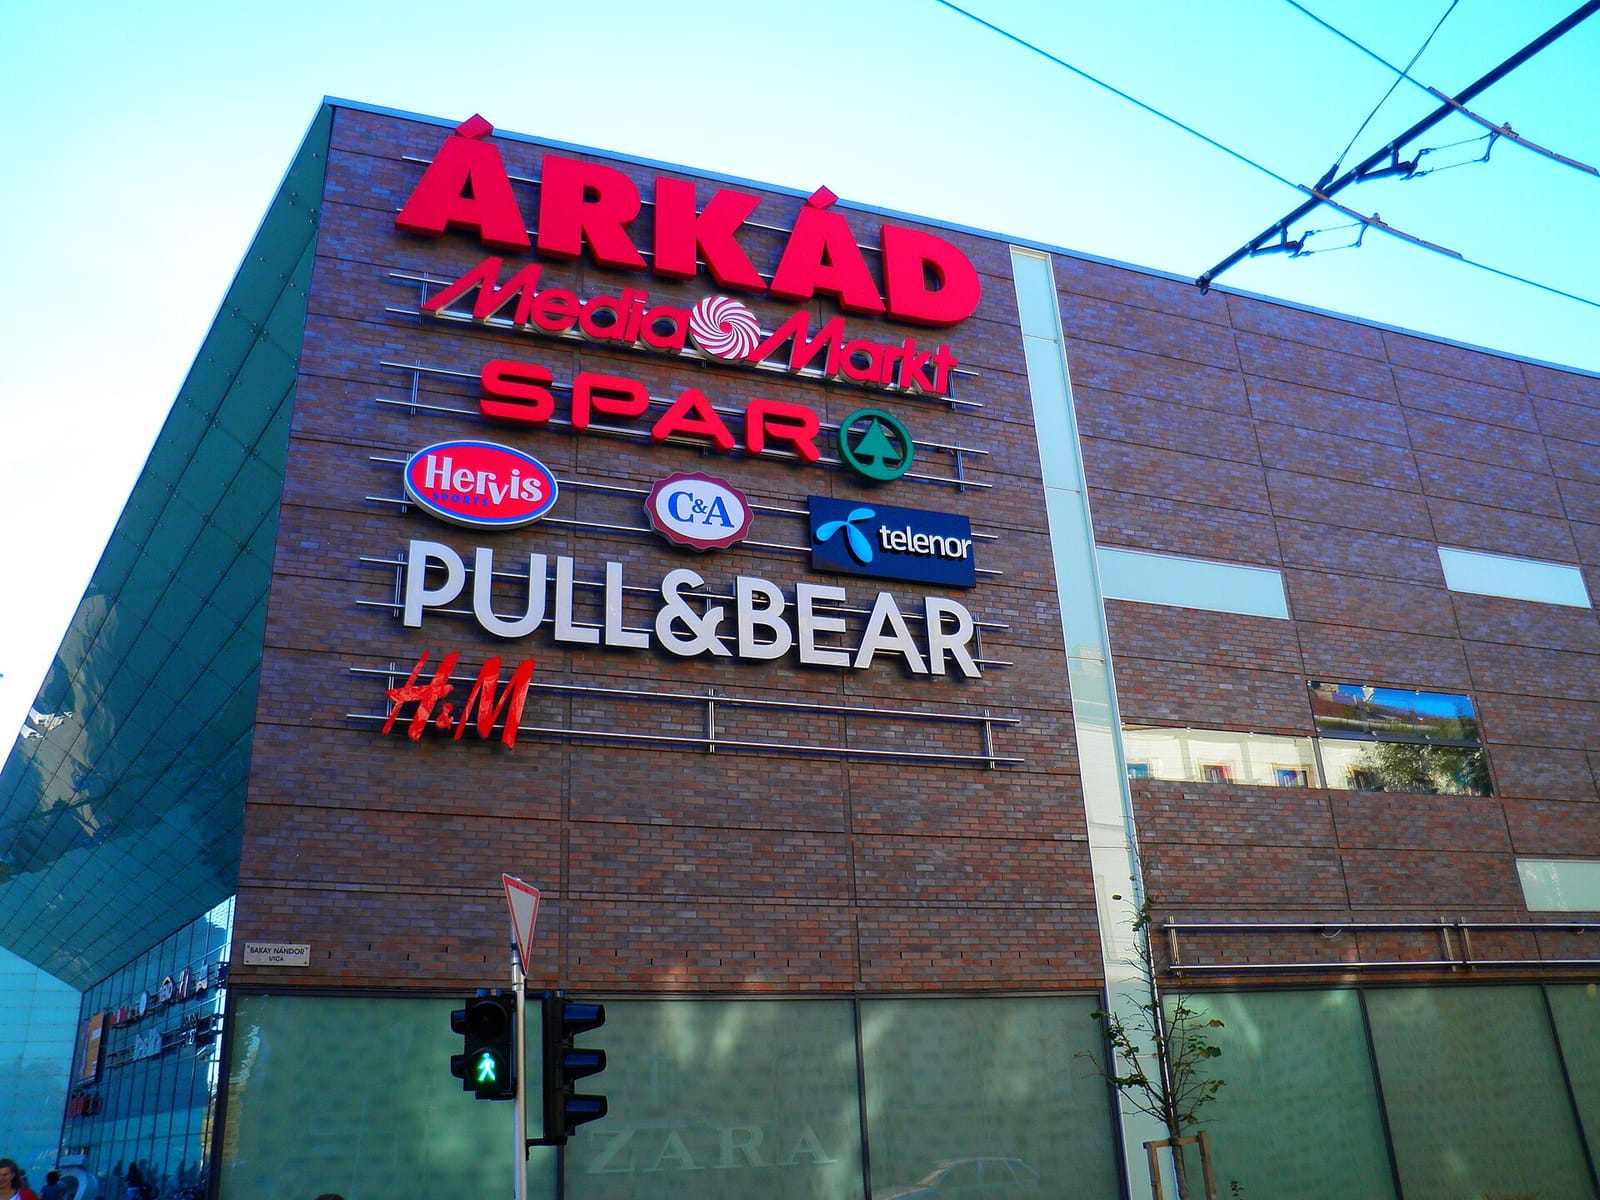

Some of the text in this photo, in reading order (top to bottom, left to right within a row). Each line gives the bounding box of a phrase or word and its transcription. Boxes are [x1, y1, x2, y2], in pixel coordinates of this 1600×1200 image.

[395, 113, 982, 328] ÁRKÁD
[421, 257, 958, 397] Media Markt
[480, 359, 822, 464] SPAR
[424, 454, 543, 505] Hervis
[432, 491, 490, 508] SPORTS
[668, 491, 735, 528] C&A
[879, 524, 972, 559] telenor
[403, 539, 982, 678] PULL&BEAR
[382, 650, 536, 750] H&M
[249, 945, 305, 955] BAKAY NÁNDOR
[585, 1124, 838, 1175] ZARA
